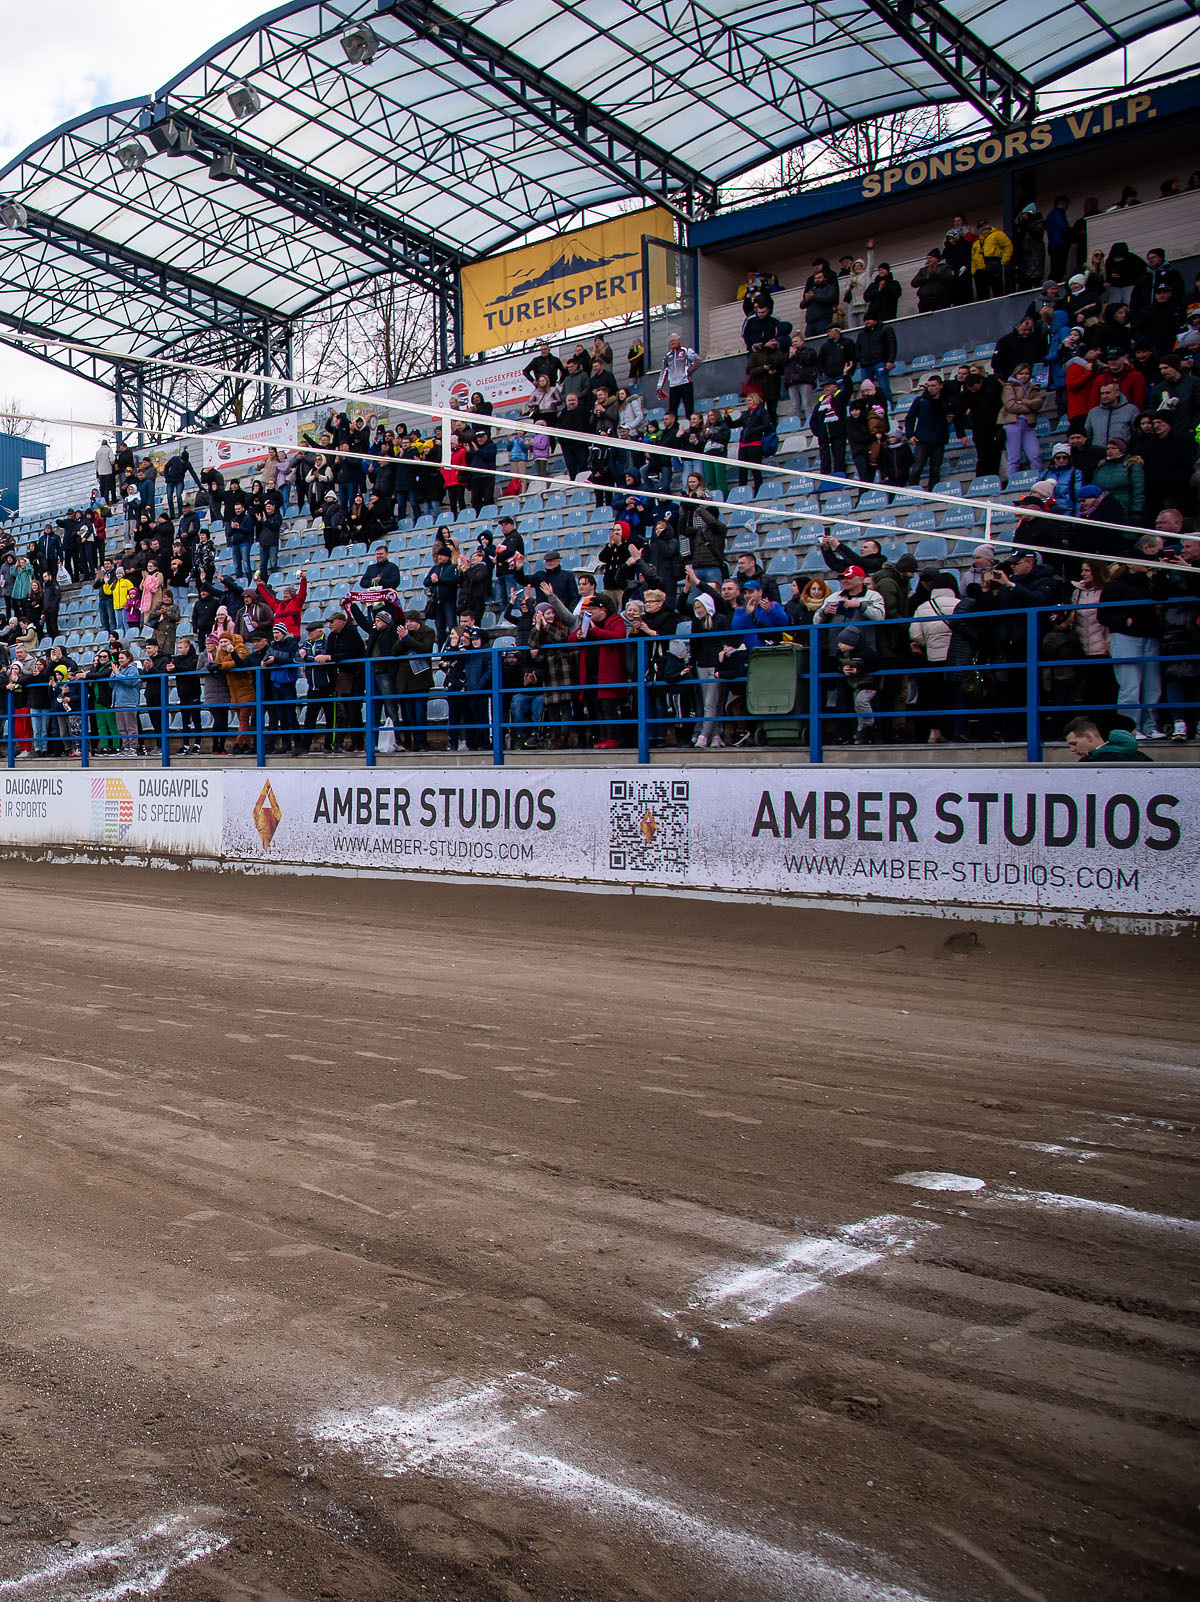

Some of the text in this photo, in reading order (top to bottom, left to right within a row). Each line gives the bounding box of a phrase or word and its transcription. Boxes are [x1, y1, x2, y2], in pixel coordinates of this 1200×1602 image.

[862, 95, 1157, 198] SPONSORS V.I.P.
[483, 269, 643, 331] TUREKSPERT
[519, 307, 611, 336] TRAVEL AGENCY
[5, 778, 63, 796] DAUGAVPILS
[139, 778, 209, 798] DAUGAVPILS
[5, 800, 47, 818] IR SPORTS
[138, 803, 203, 824] IS SPEEDWAY
[314, 787, 557, 830] AMBER STUDIOS
[751, 790, 1181, 850] AMBER STUDIOS
[333, 836, 534, 861] WWW.AMBER-STUDIOS.COM
[784, 854, 1140, 891] WWW.AMBER-STUDIOS.COM
